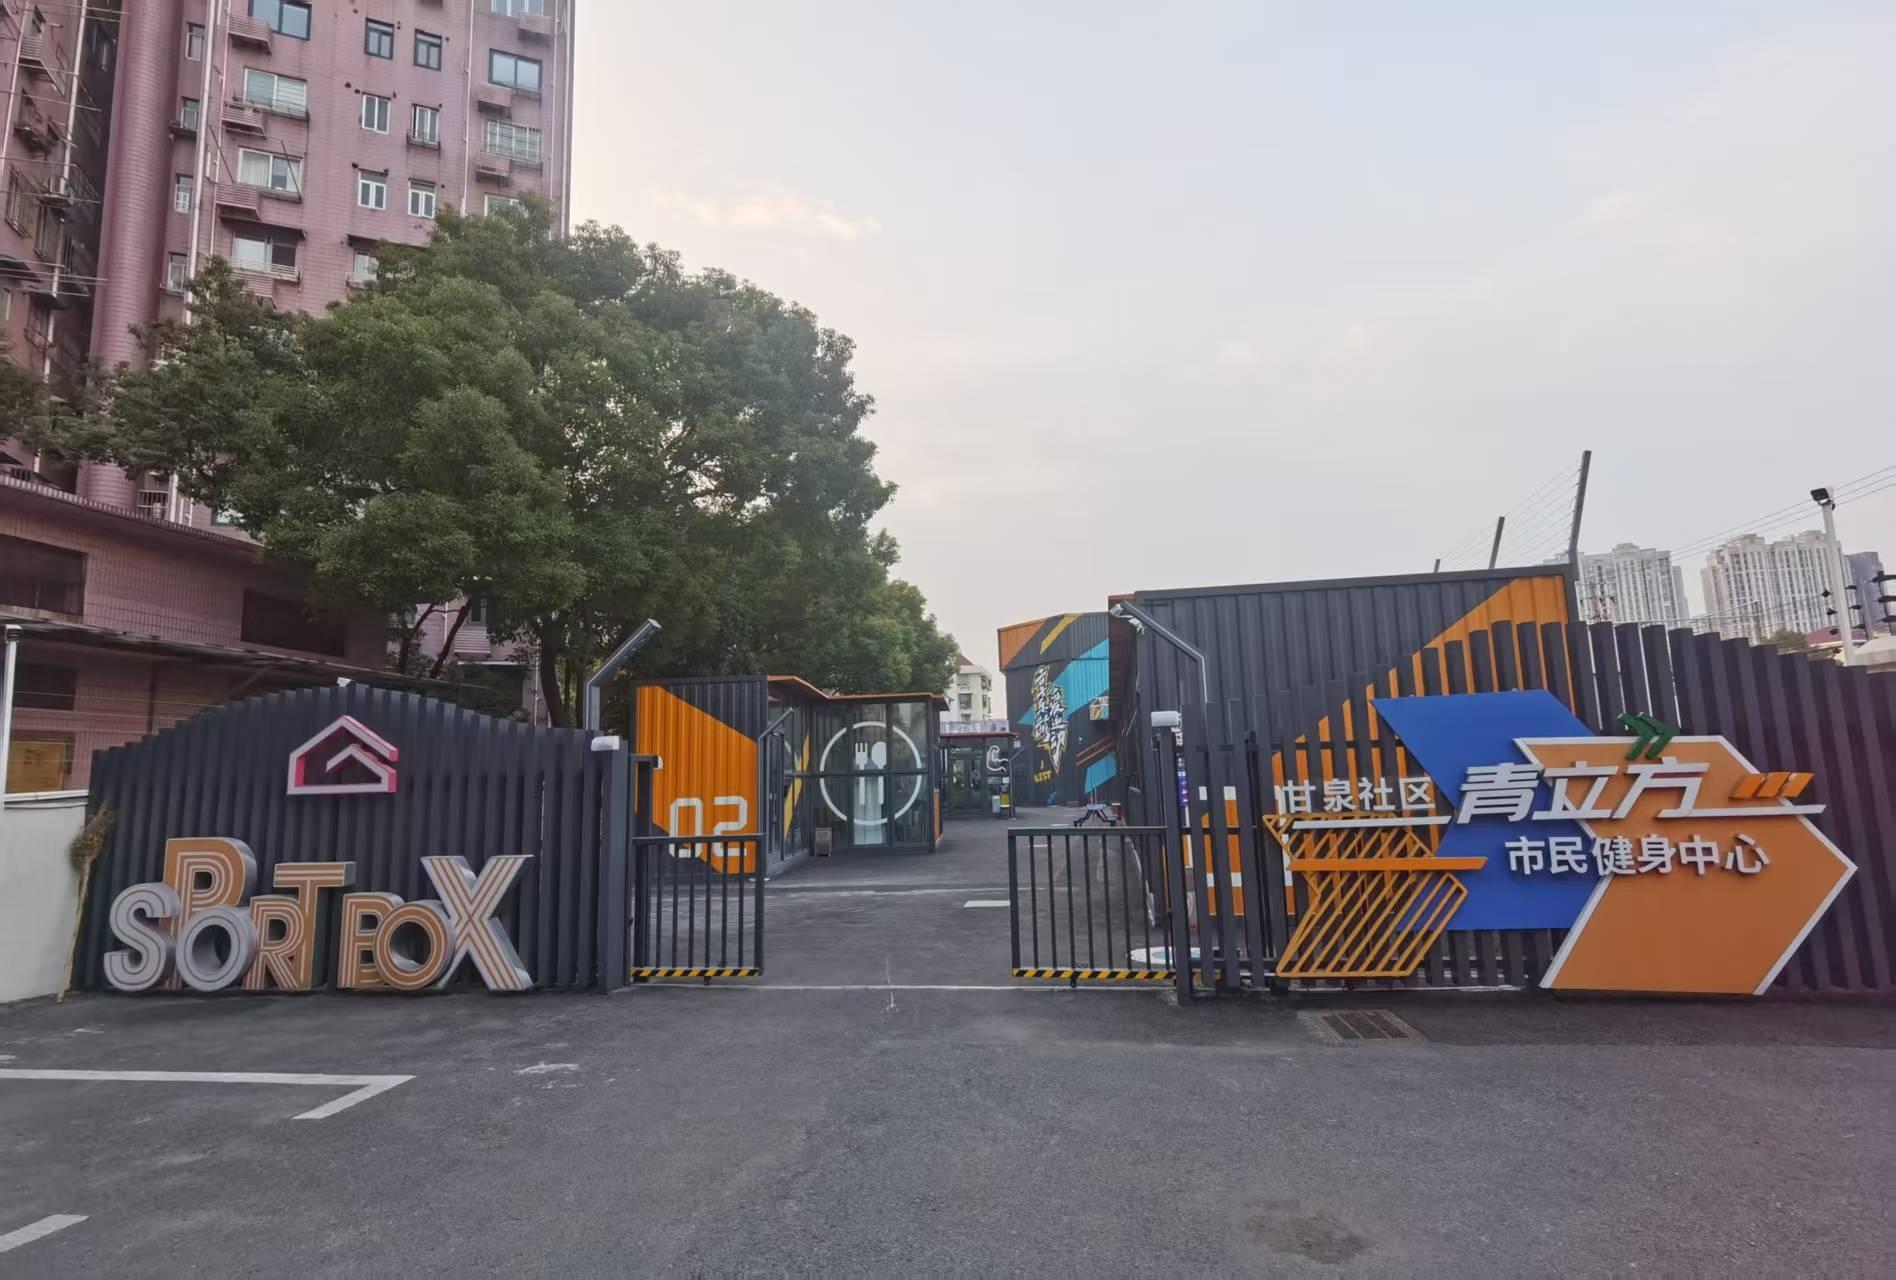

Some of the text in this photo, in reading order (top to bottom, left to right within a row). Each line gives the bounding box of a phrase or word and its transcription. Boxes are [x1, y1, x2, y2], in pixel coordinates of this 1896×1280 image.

[1281, 776, 1436, 814] 甘泉社区
[1457, 757, 1710, 824] 青立方
[669, 795, 748, 859] 02
[1505, 834, 1770, 876] 市民健身中心
